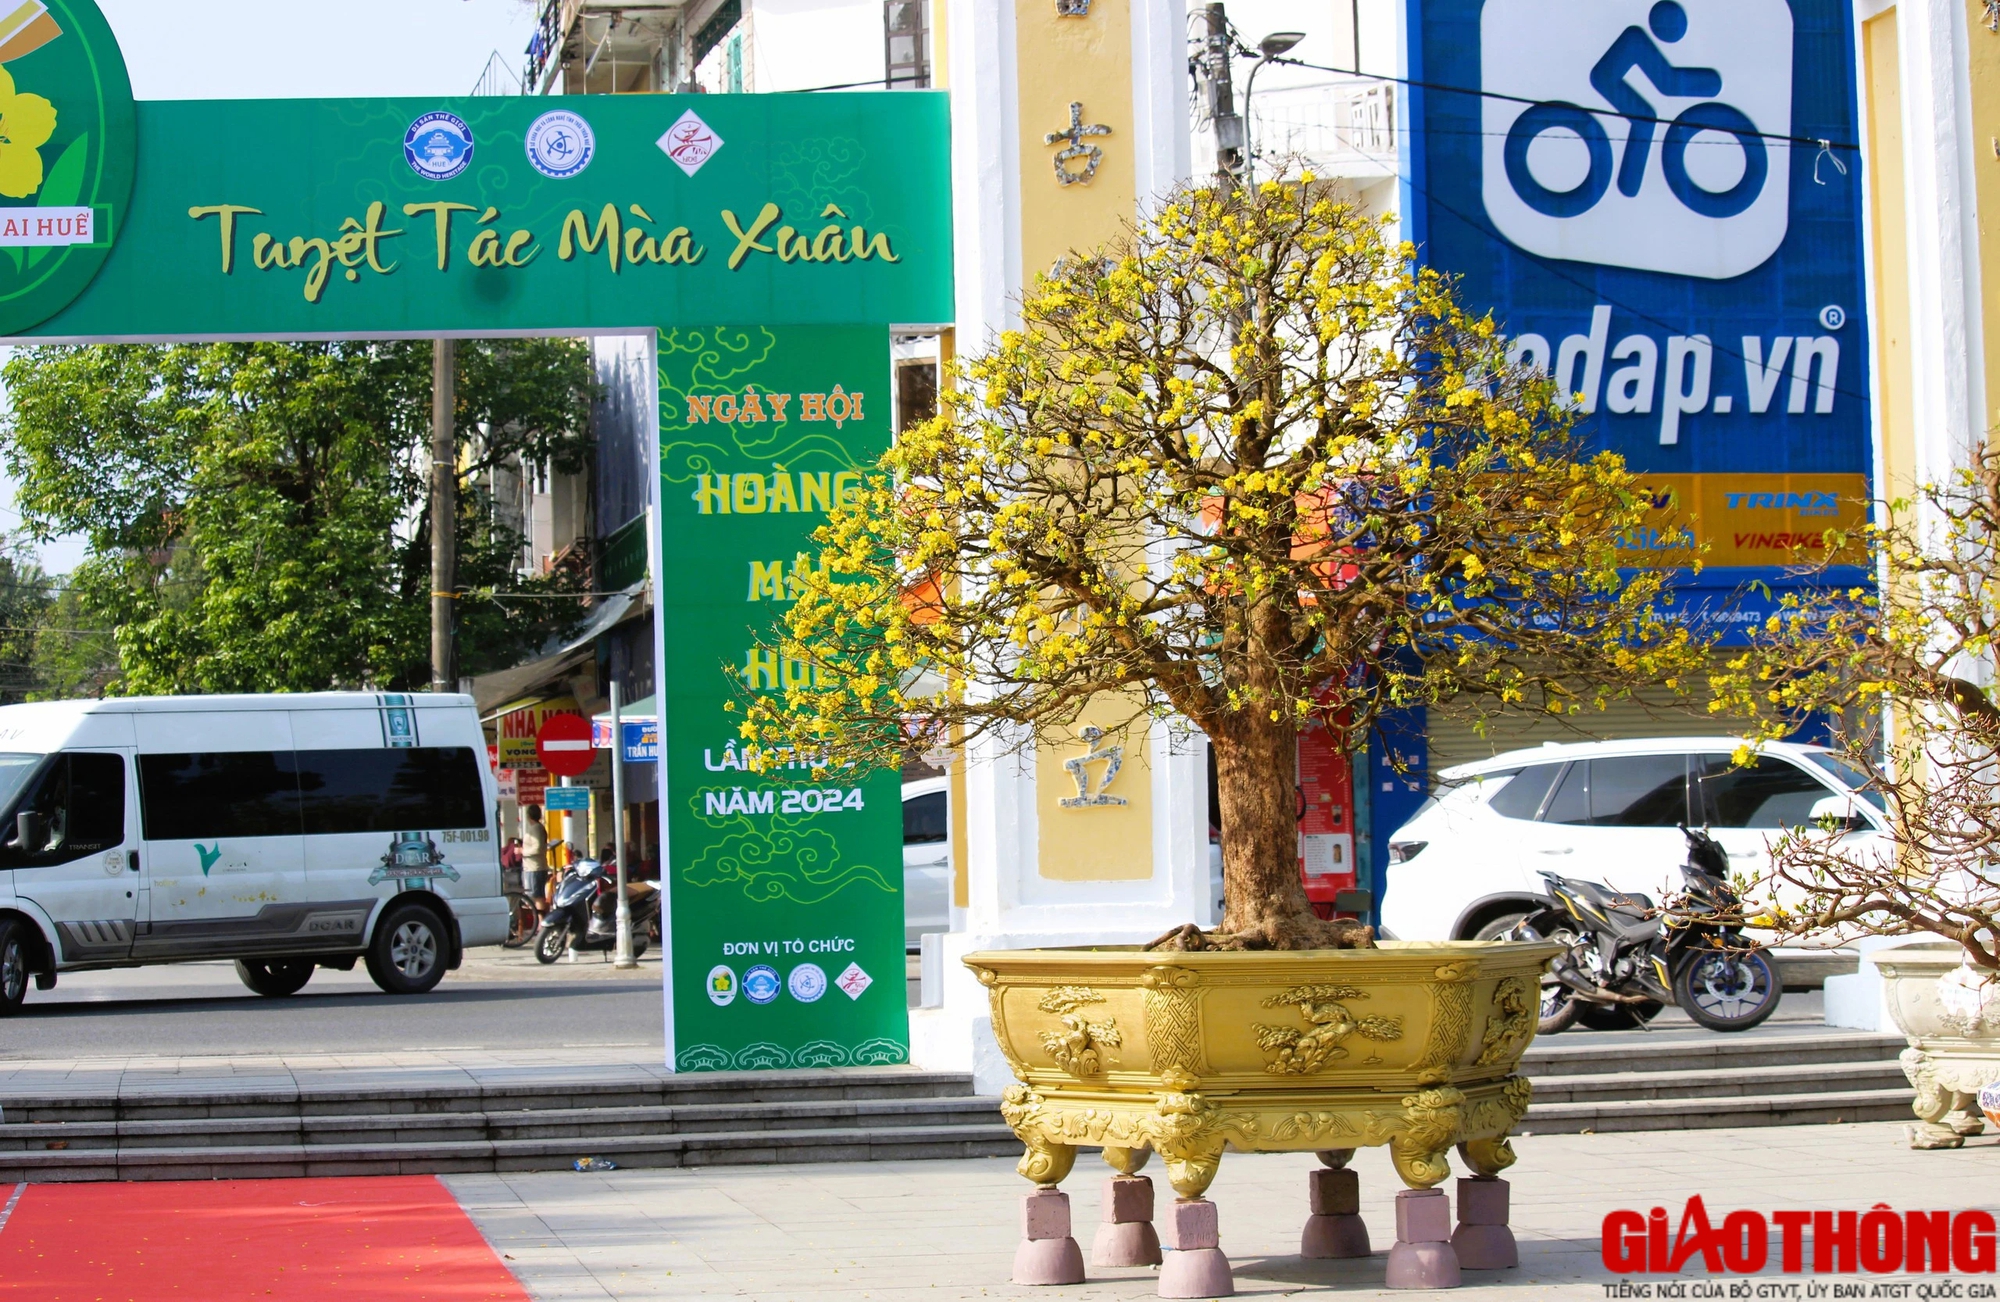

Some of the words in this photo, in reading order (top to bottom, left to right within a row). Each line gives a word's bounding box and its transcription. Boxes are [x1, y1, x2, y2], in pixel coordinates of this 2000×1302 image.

[411, 124, 420, 133] DI
[420, 114, 434, 125] SẢN
[435, 112, 449, 120] THẾ
[450, 117, 467, 132] GIỚI
[411, 161, 421, 172] THE
[420, 169, 441, 179] WORLD
[441, 161, 467, 179] HERITAGE
[188, 201, 404, 302] Tuyệt
[403, 201, 541, 271] Tác
[557, 202, 704, 274] Mùa
[721, 202, 900, 270] Xuân
[1468, 304, 1840, 445] edap.vn
[686, 386, 791, 424] NGÀY
[799, 384, 864, 429] HỘI
[692, 462, 864, 514] HOÀNG
[1724, 490, 1838, 509] TRINX
[706, 786, 774, 815] NĂM
[781, 788, 865, 814] 2024
[442, 830, 490, 843] 75F-001.98
[395, 852, 431, 865] DCAR
[309, 919, 355, 931] DCAR
[723, 942, 759, 955] ĐƠN
[763, 941, 778, 957] VỊ
[808, 936, 855, 953] CHỨC
